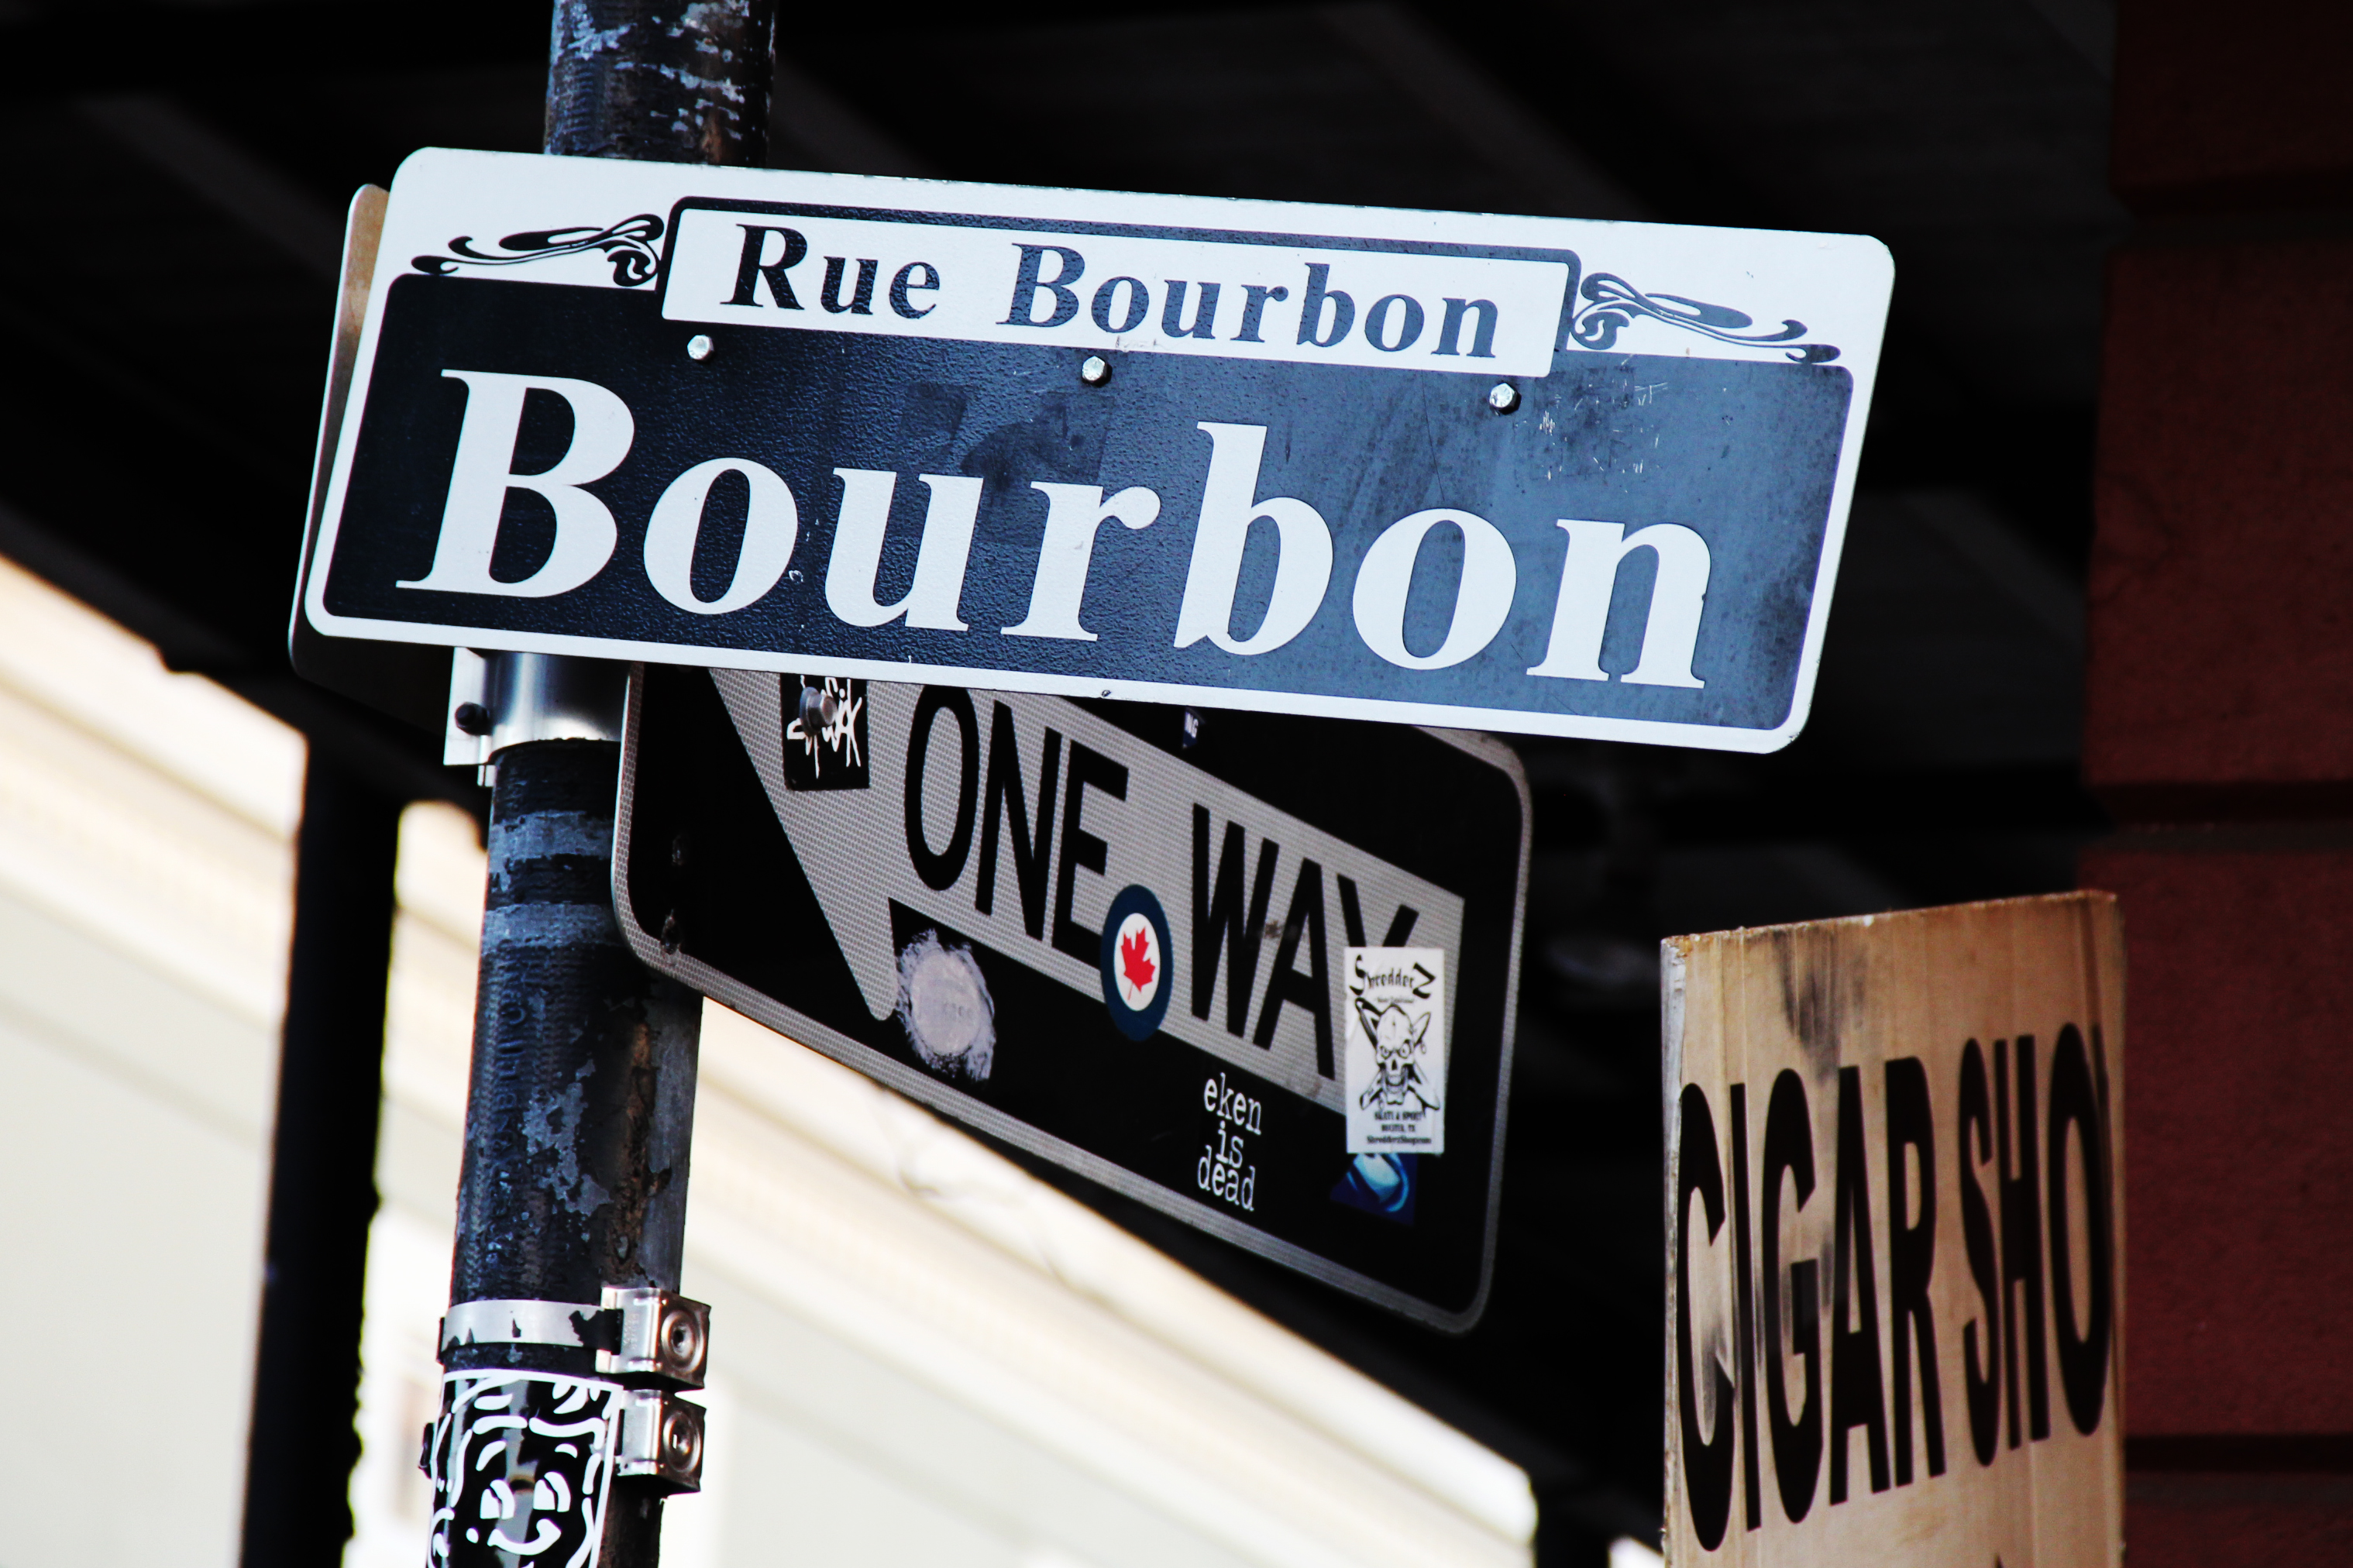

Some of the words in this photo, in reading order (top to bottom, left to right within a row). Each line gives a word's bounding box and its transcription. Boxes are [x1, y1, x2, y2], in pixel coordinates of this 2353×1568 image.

[718, 223, 942, 320] Rue
[996, 242, 1498, 358] Bourbon
[395, 367, 1713, 689] Bourbon
[904, 683, 1130, 971] ONE
[1204, 1072, 1261, 1136] eken
[1216, 1120, 1244, 1169] is
[1198, 1144, 1256, 1212] dead
[1676, 1056, 1946, 1553] CIGAR
